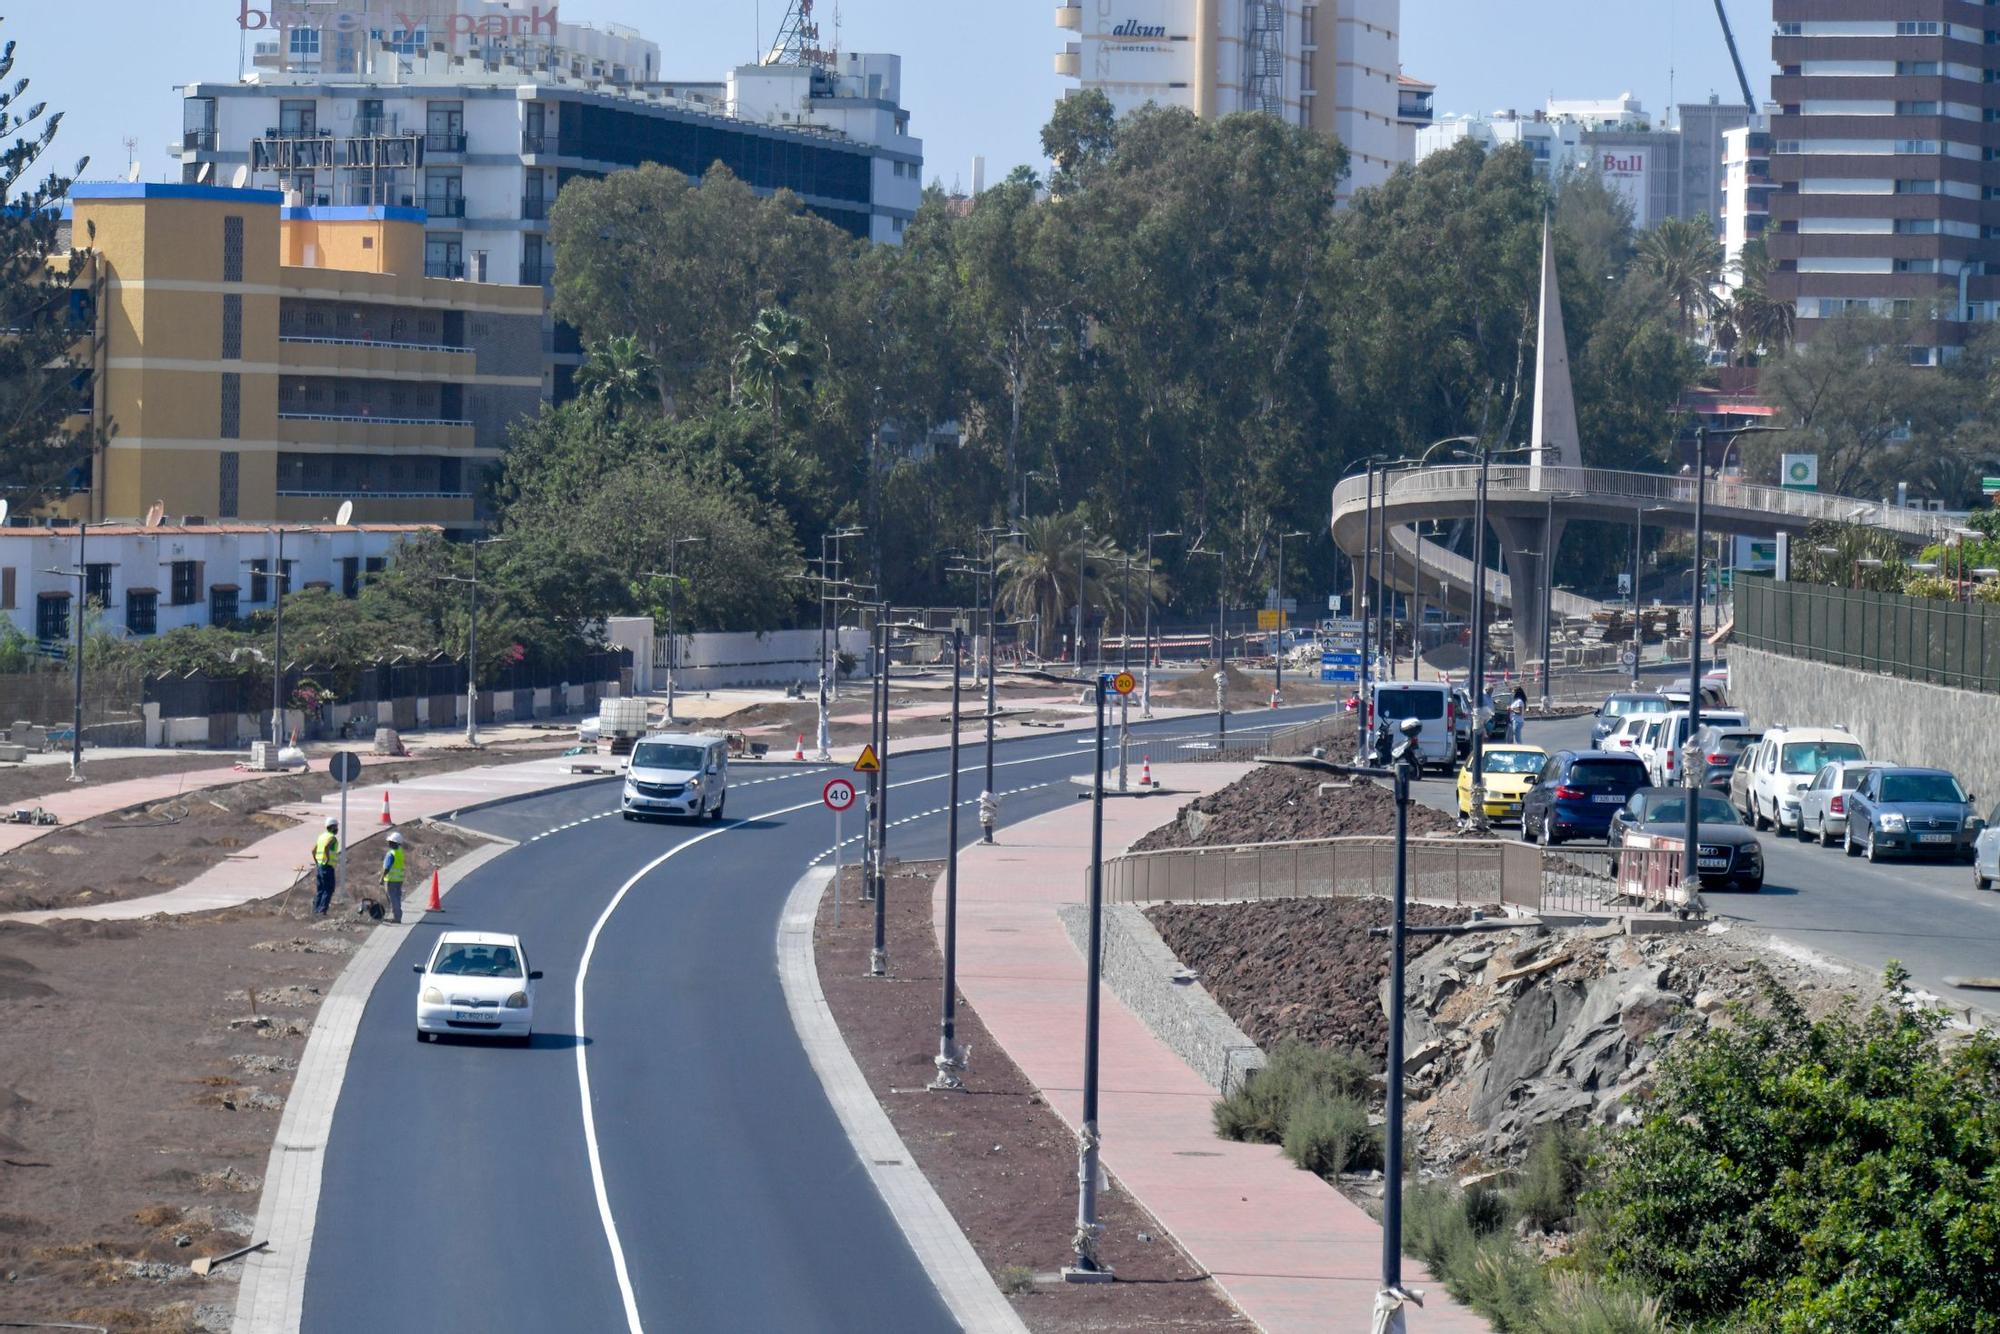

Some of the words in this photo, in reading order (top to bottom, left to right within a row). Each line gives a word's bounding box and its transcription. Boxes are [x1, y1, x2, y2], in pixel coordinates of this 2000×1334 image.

[448, 6, 558, 46] park
[1113, 19, 1166, 37] allsun
[1603, 155, 1642, 171] Bull
[830, 790, 849, 800] 40
